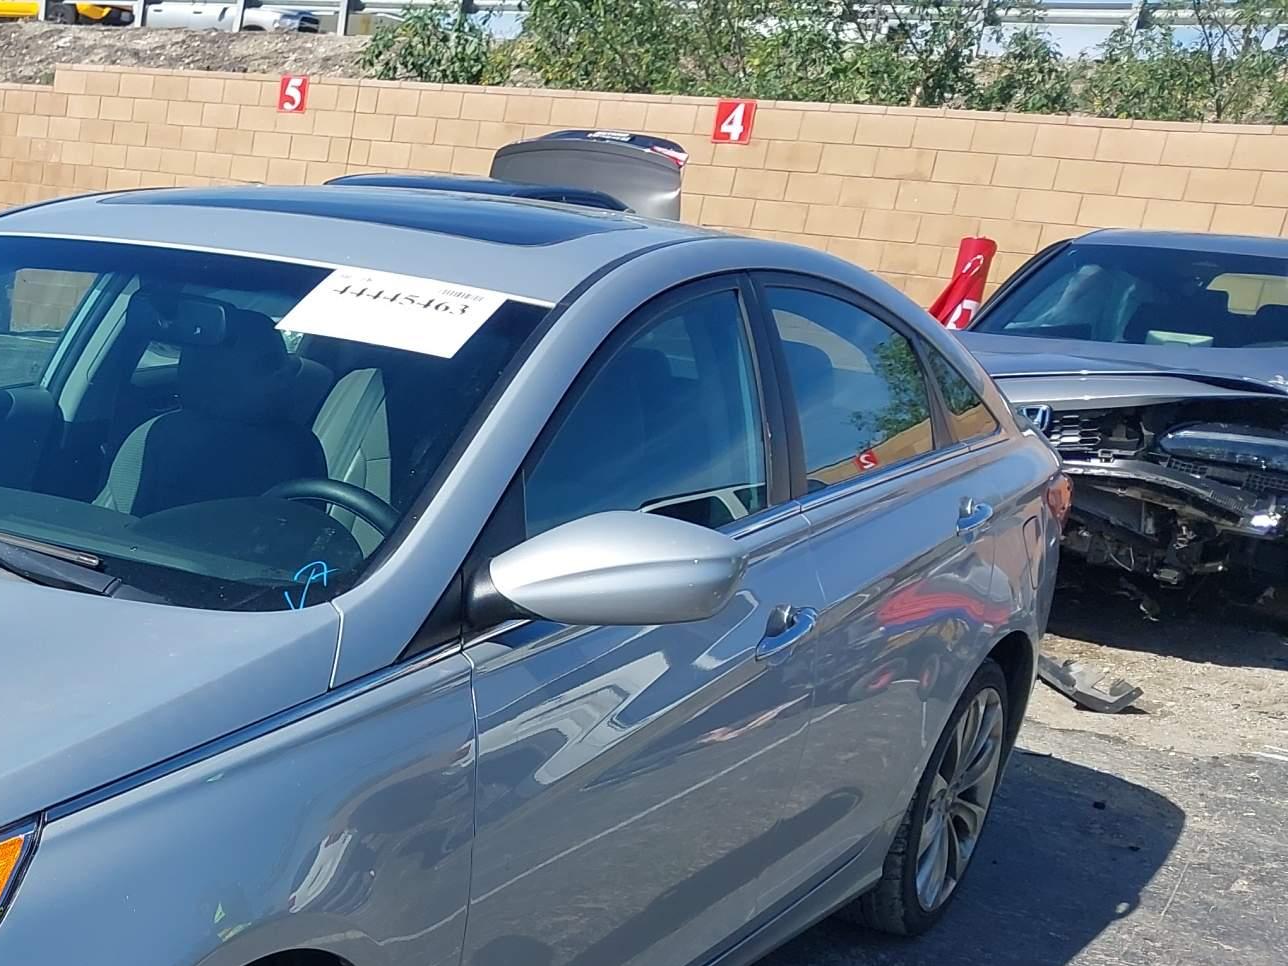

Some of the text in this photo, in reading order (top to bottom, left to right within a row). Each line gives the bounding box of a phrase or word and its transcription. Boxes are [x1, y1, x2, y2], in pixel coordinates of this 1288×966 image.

[283, 78, 303, 110] 5
[720, 103, 745, 141] 4
[332, 283, 470, 316] 44445463
